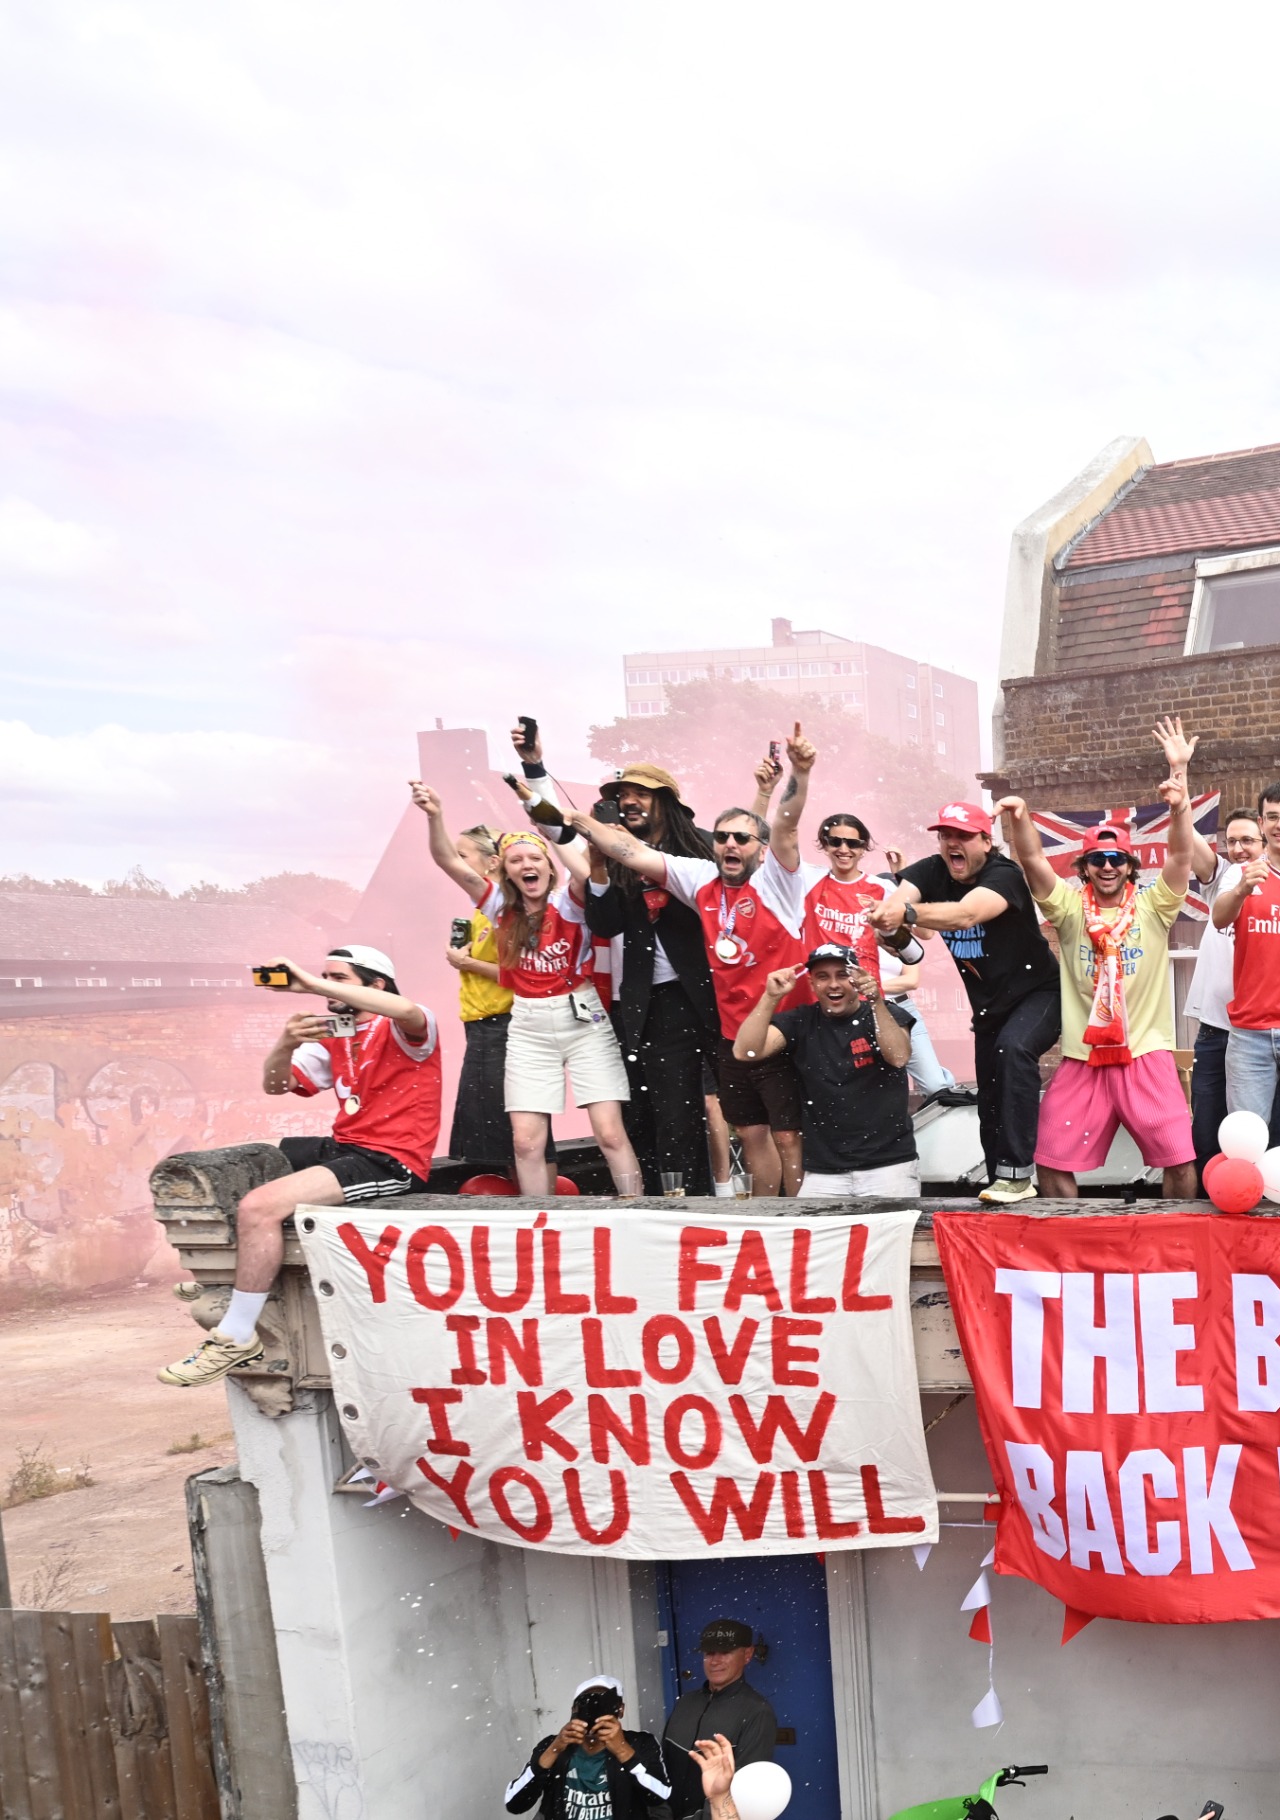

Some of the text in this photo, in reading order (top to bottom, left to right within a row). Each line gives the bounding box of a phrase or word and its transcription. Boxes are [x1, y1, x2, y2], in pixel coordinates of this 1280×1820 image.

[814, 903, 869, 925] Emirate
[678, 1224, 892, 1315] FALL
[446, 1314, 823, 1389] IN LOVE
[994, 1267, 1204, 1414] THE
[410, 1388, 837, 1471] I KNOW
[416, 1457, 925, 1546] YOU WILL
[1004, 1440, 1256, 1577] BACK
